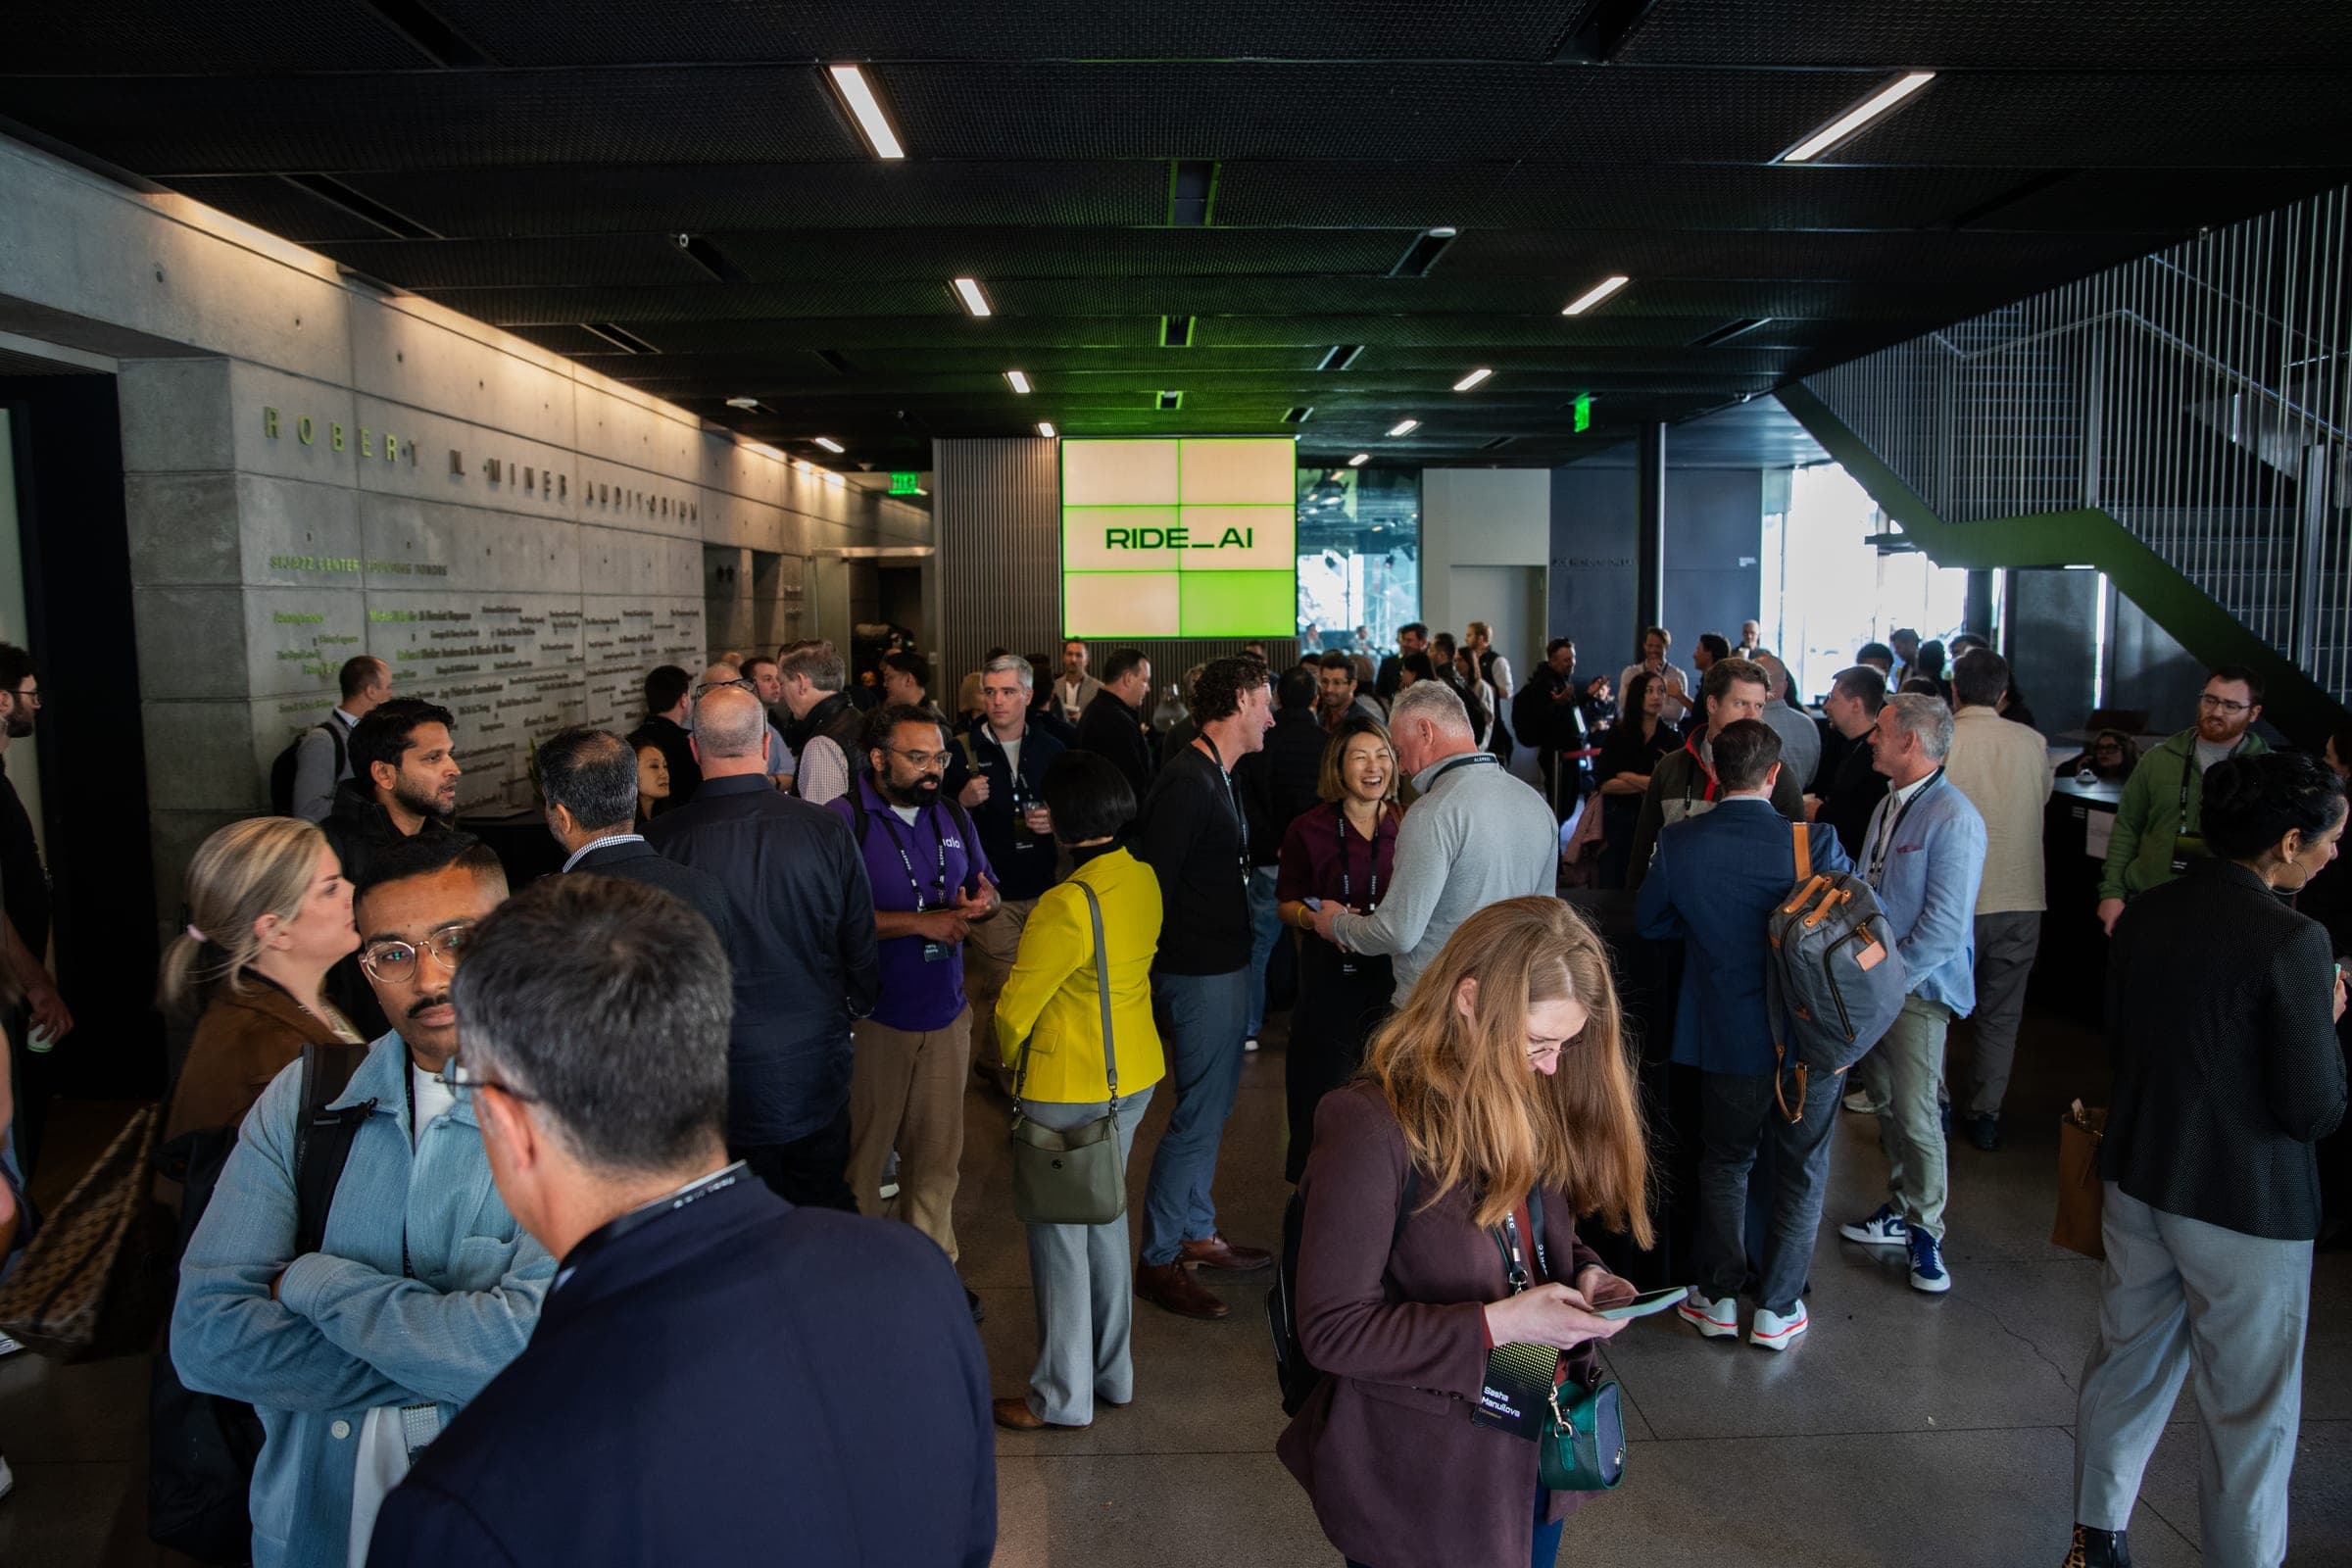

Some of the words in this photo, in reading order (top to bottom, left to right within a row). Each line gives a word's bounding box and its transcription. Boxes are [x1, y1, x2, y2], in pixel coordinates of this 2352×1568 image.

[265, 407, 419, 467] ROBERT
[488, 458, 567, 497] MINER
[588, 481, 698, 521] AUDITORIUM
[1105, 527, 1252, 549] RIDE_AI
[1483, 1386, 1509, 1402] Sasha
[1481, 1396, 1521, 1418] Manuilova
